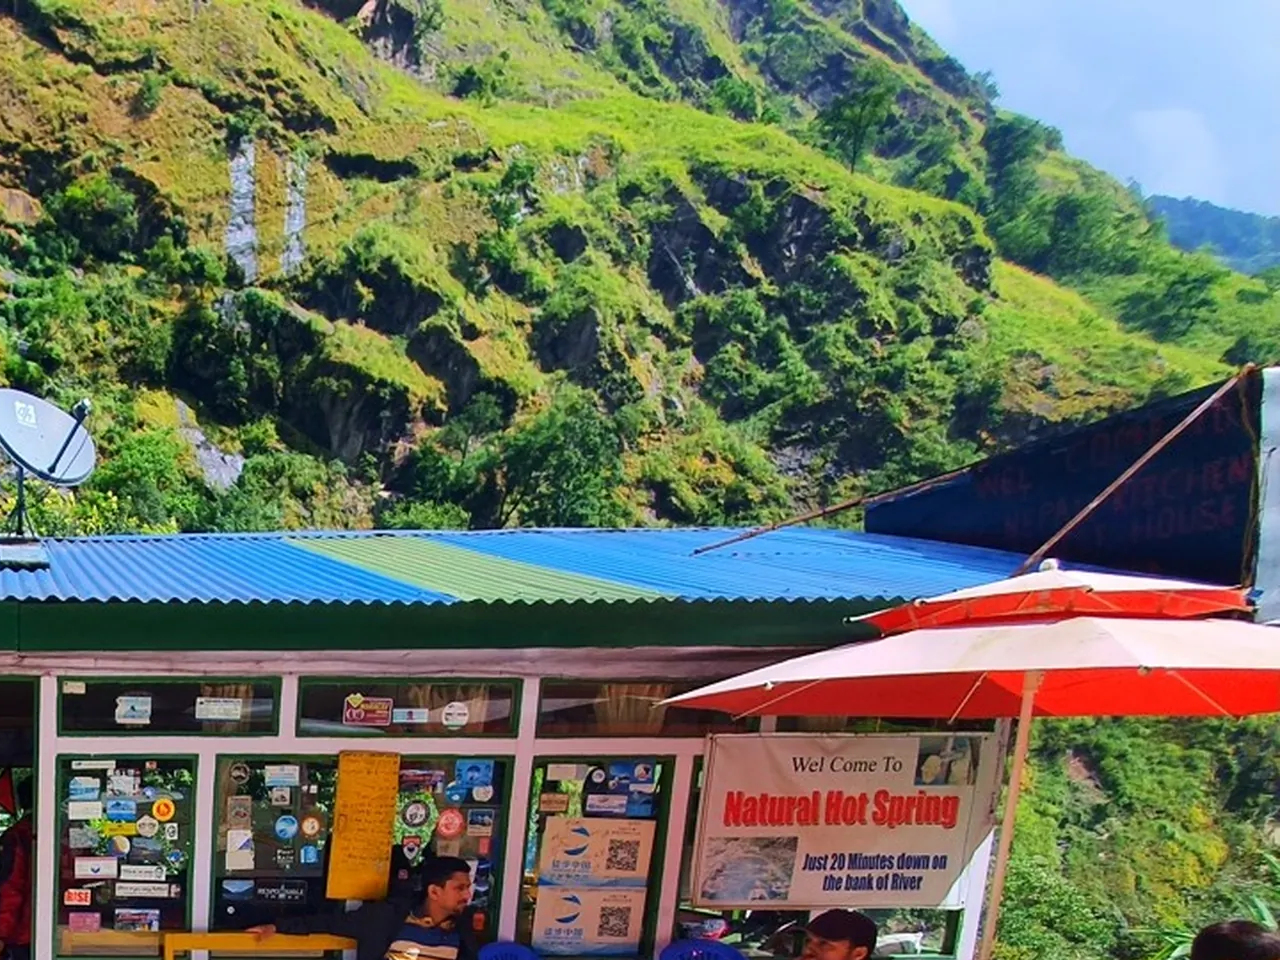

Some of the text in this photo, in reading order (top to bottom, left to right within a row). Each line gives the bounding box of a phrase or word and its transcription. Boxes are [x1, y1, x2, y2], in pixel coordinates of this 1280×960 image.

[792, 755, 903, 773] Wel Come To
[723, 788, 961, 829] Natural Hot Spring
[802, 852, 948, 871] Just 20 Minutes down on
[822, 872, 923, 891] the bank of River
[65, 890, 89, 903] RISE
